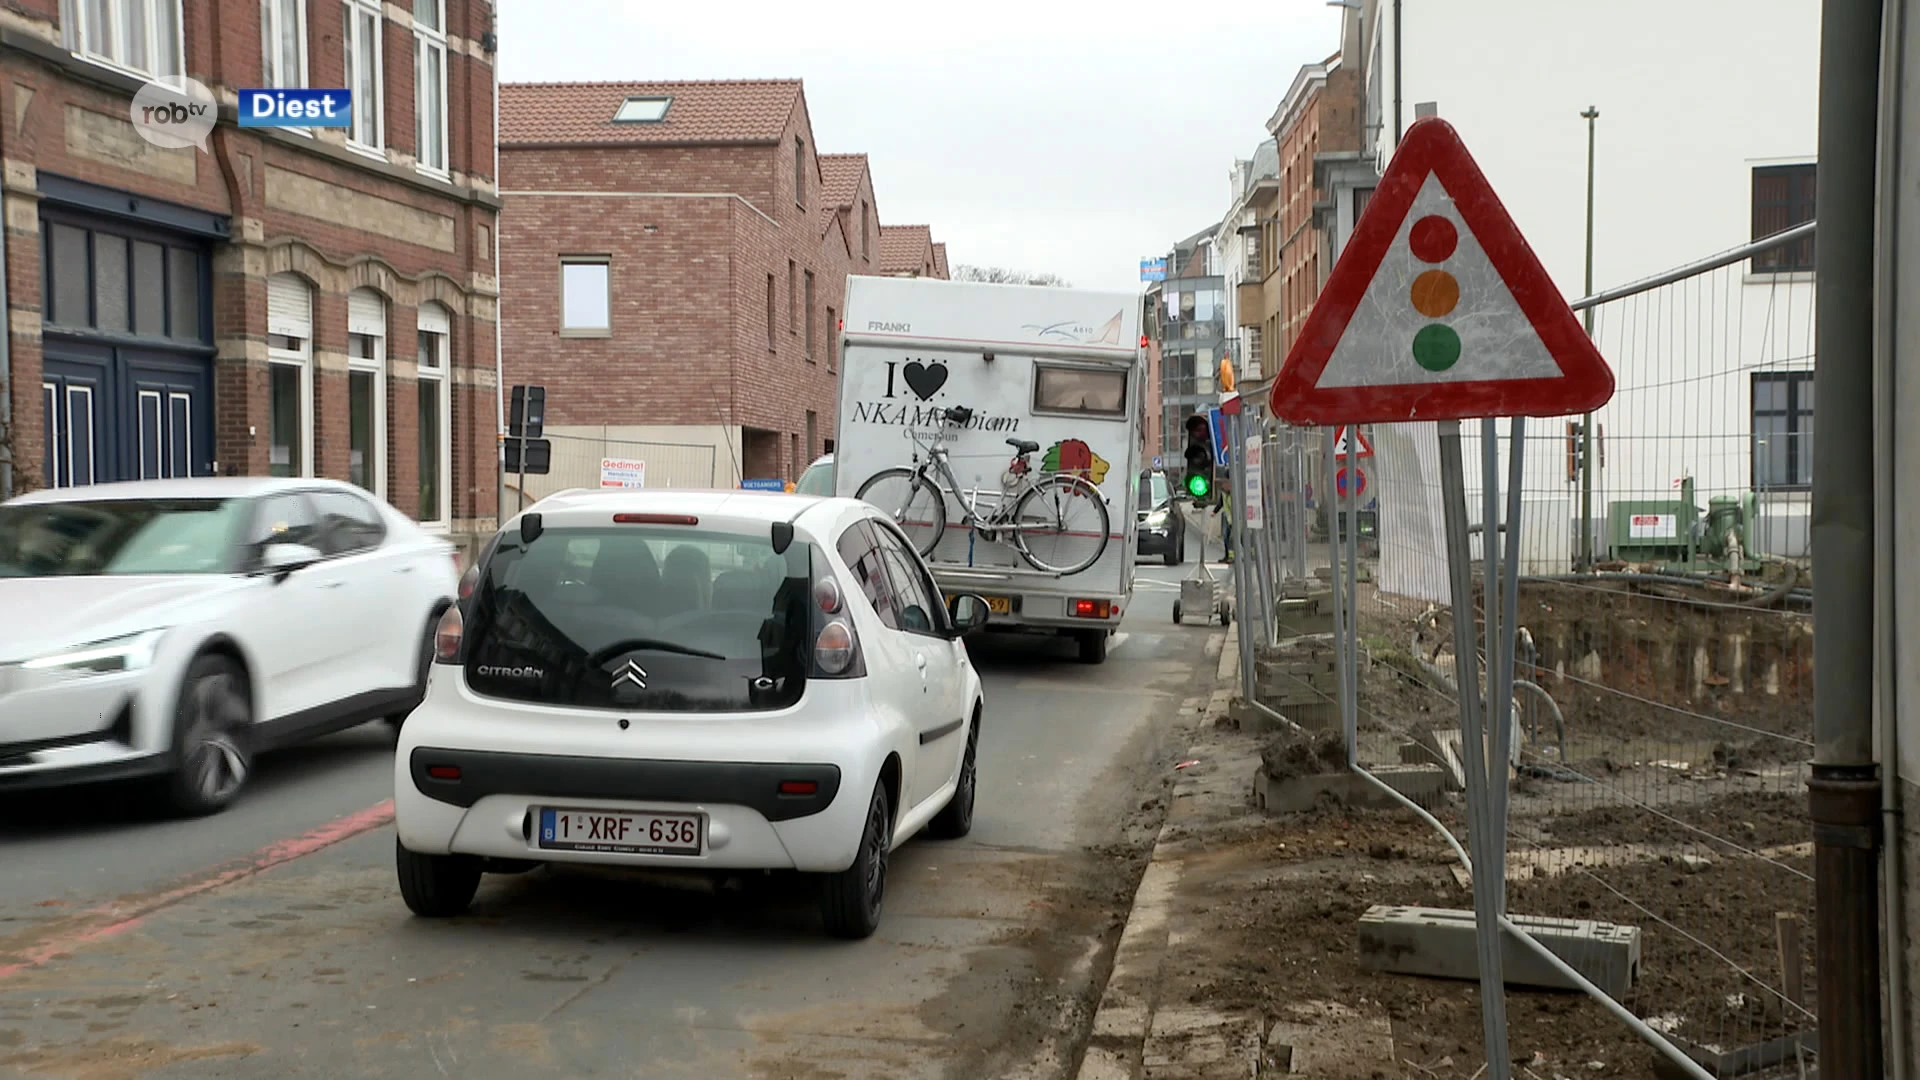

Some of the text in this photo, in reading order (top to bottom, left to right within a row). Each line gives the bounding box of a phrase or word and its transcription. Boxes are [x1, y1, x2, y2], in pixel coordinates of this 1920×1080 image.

[882, 360, 898, 399] I
[602, 459, 644, 471] Gedimat
[477, 665, 544, 678] CITROËN
[754, 676, 786, 692] C1
[544, 828, 553, 839] B
